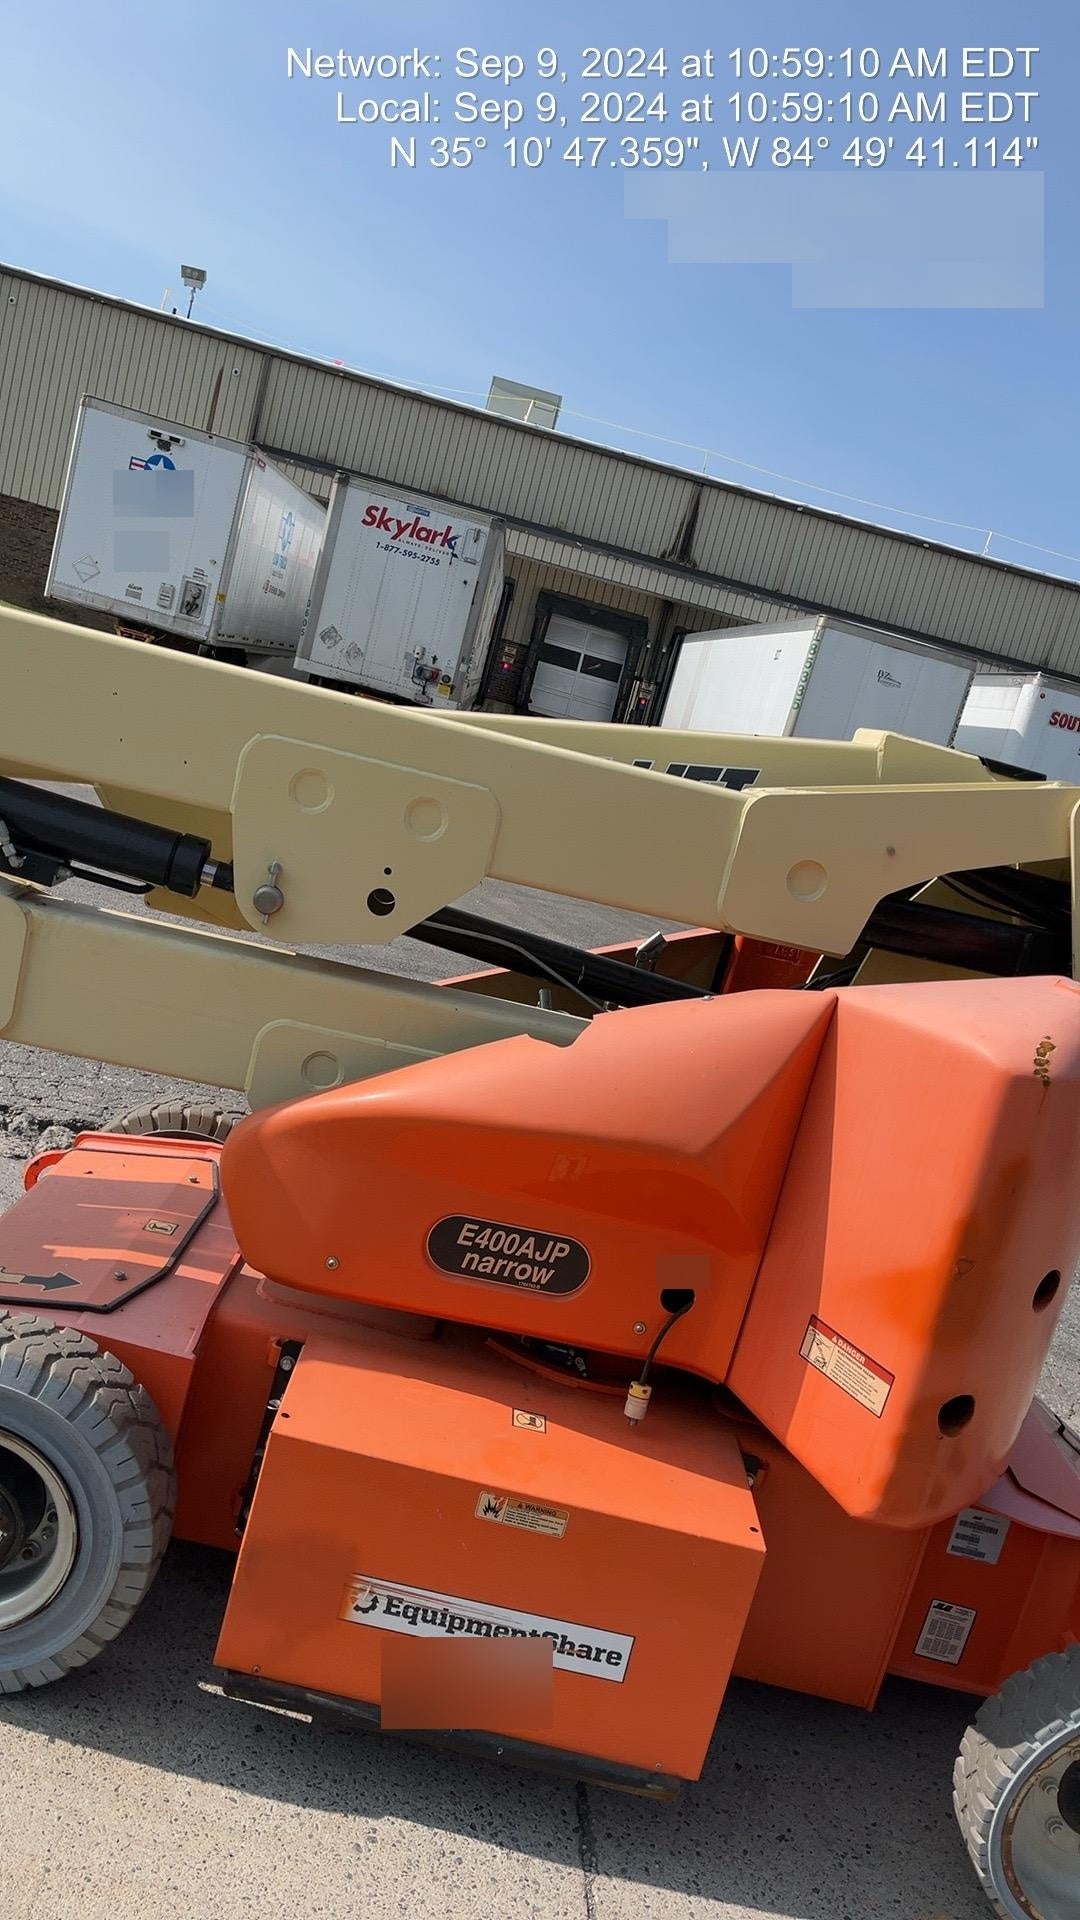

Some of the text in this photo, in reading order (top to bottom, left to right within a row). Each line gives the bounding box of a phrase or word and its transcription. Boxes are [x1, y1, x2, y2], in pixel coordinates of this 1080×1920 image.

[361, 505, 460, 550] Skylark
[376, 541, 440, 566] 1-877-595-2755
[456, 1223, 571, 1264] E400AJP
[461, 1252, 556, 1286] narrow
[837, 1339, 866, 1364] DANGER
[525, 1503, 557, 1518] WARNING
